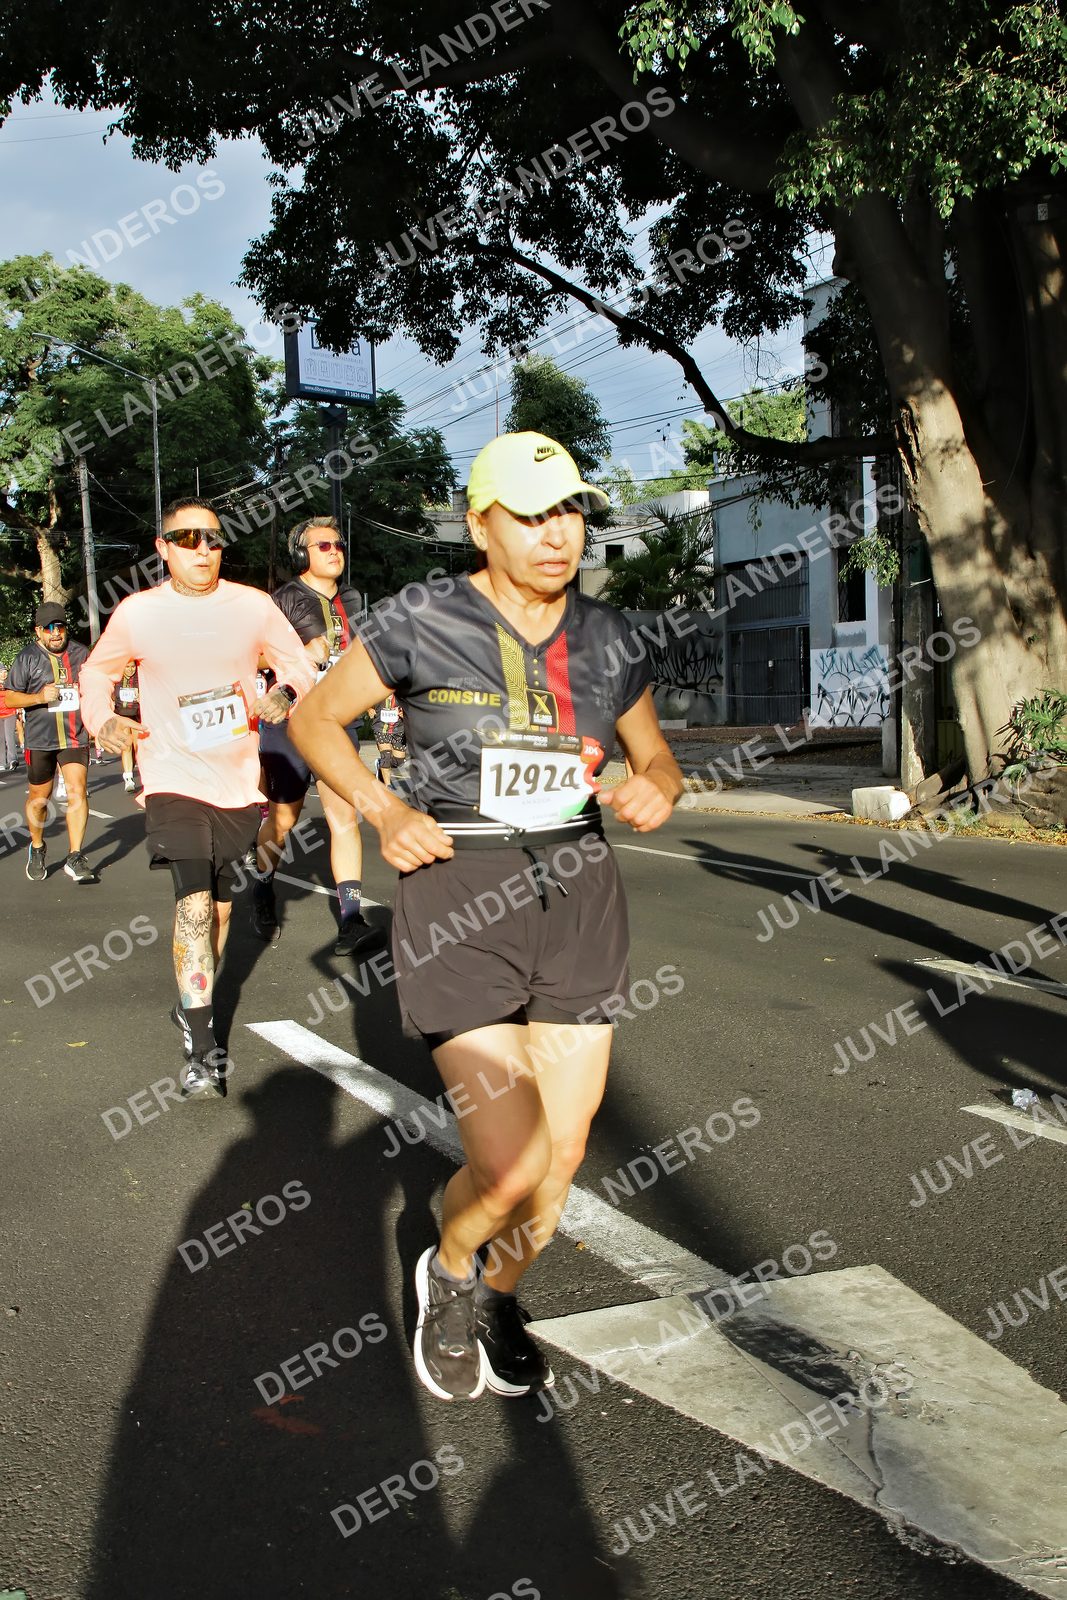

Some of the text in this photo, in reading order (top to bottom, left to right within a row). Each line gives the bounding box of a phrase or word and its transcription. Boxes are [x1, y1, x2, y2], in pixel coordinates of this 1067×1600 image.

[428, 689, 501, 707] CONSUE
[191, 703, 236, 730] 9271
[490, 763, 580, 796] 12924
